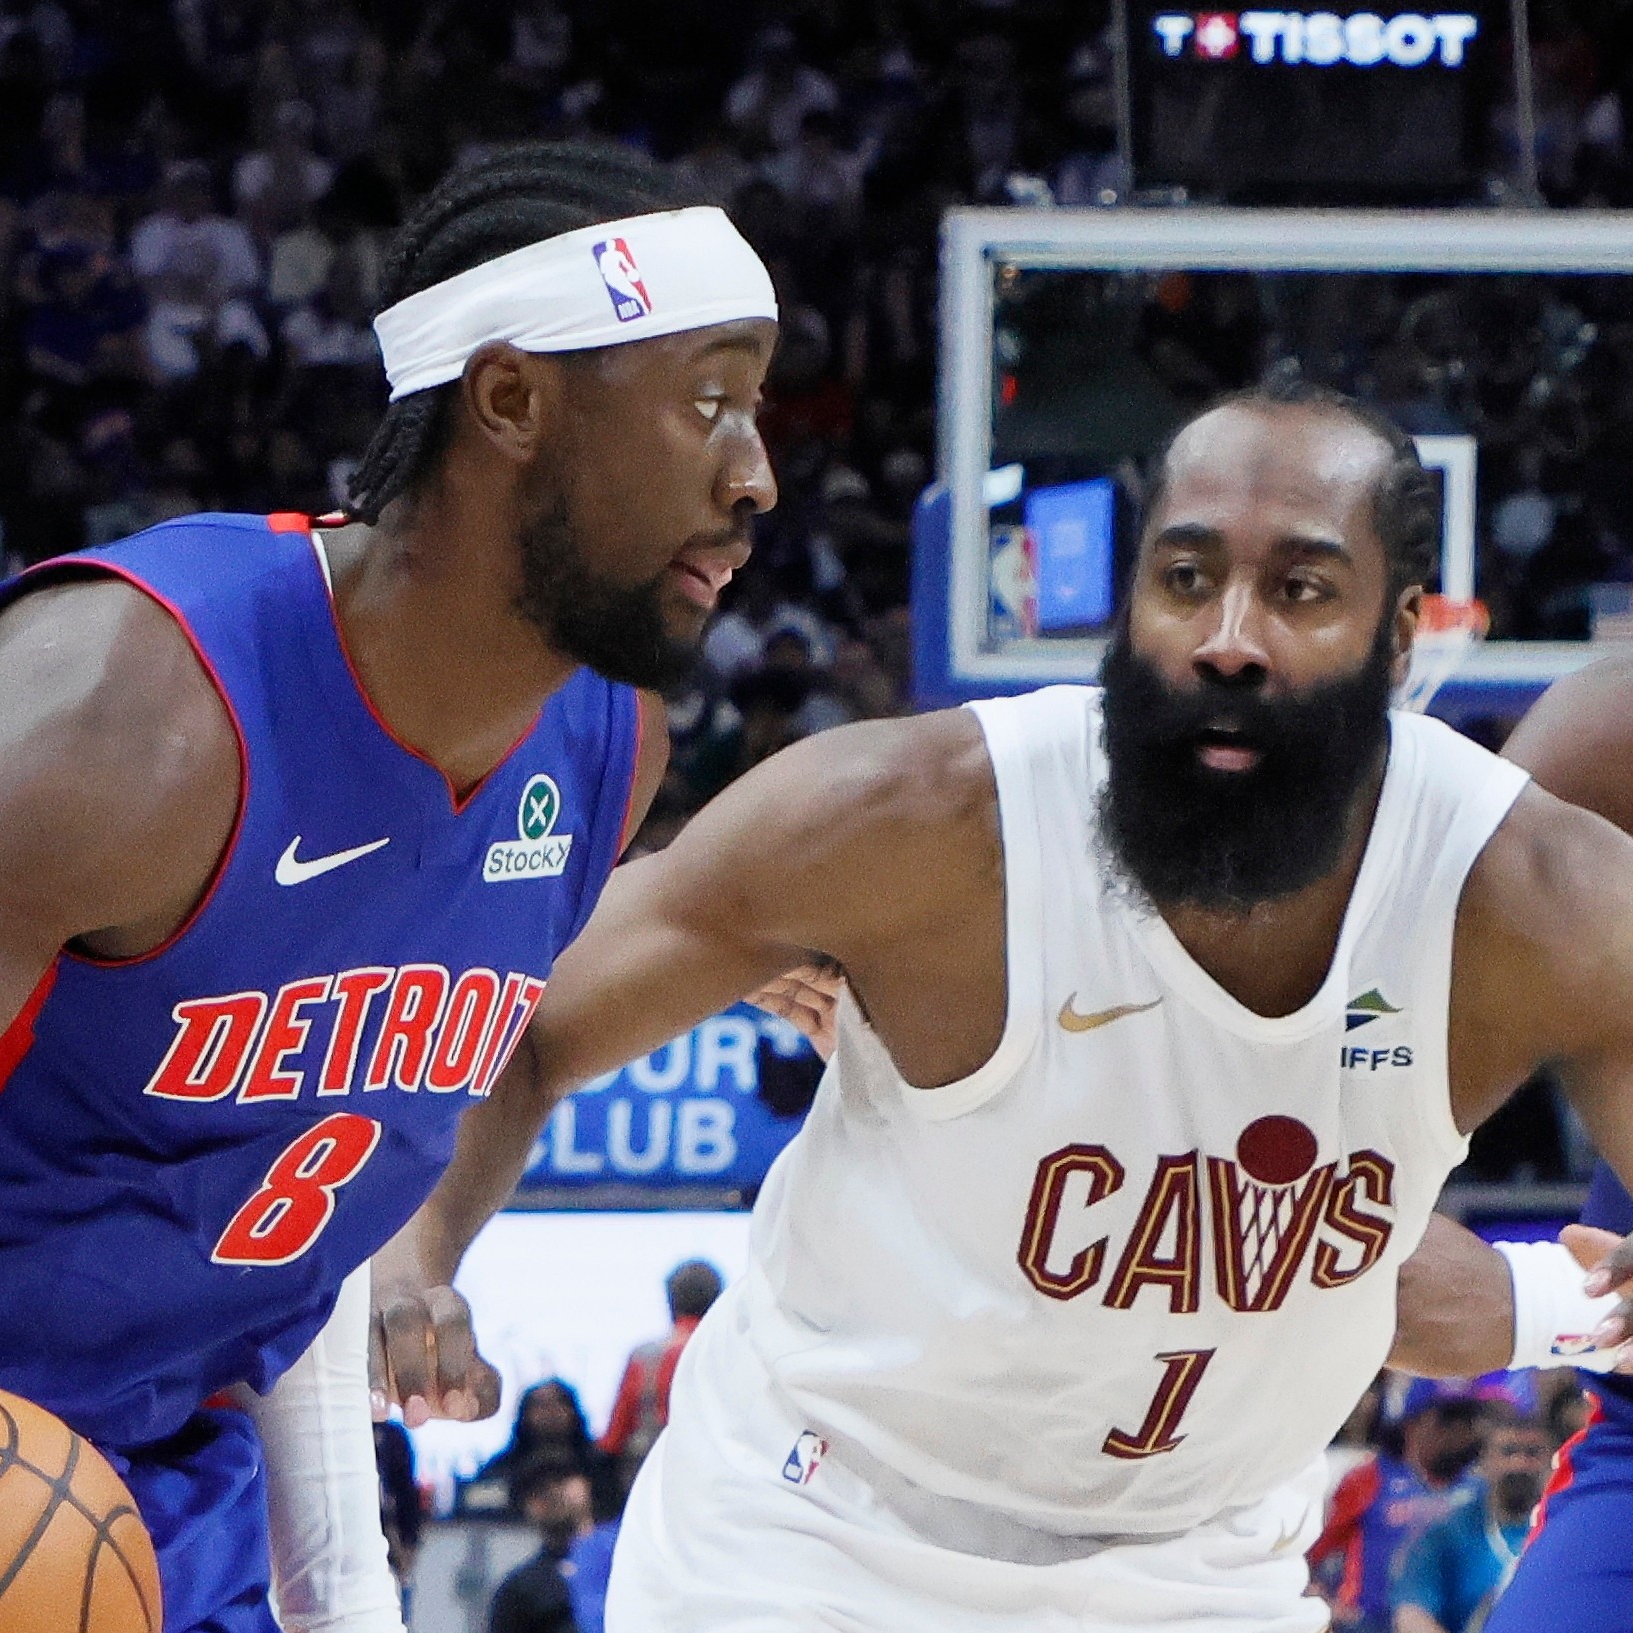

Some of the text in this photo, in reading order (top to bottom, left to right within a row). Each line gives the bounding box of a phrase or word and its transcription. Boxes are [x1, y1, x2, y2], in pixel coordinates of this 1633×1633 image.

[1240, 10, 1478, 66] TISSOT
[210, 1112, 382, 1267] 8
[525, 1099, 739, 1174] LUB
[1017, 1143, 1396, 1313] CAVS
[1101, 1347, 1218, 1460] 1
